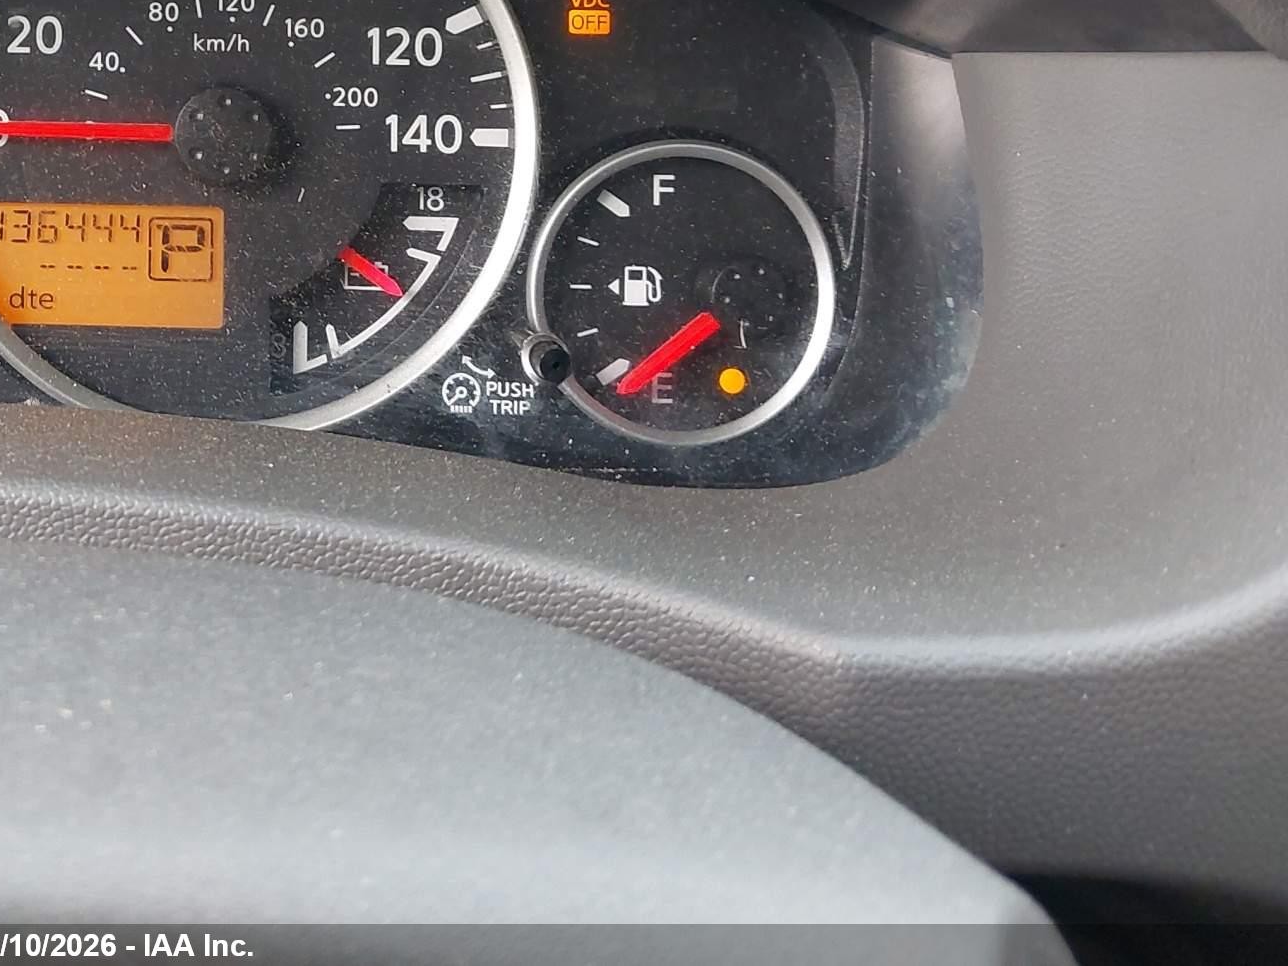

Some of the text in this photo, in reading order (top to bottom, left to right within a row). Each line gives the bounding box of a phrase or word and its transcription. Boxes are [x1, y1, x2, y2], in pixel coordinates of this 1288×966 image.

[149, 2, 178, 21] 80
[571, 13, 609, 31] OFF
[8, 16, 62, 54] 20
[286, 19, 324, 37] 160
[194, 34, 249, 51] km/h
[367, 26, 444, 67] 120
[89, 52, 118, 72] 40
[333, 87, 377, 107] 200
[386, 115, 462, 154] 140
[420, 189, 444, 211] 18
[654, 175, 674, 205] F
[157, 224, 205, 273] P
[9, 285, 54, 310] dte
[486, 381, 534, 398] PUSH
[652, 373, 673, 403] E
[490, 400, 530, 415] TRIP
